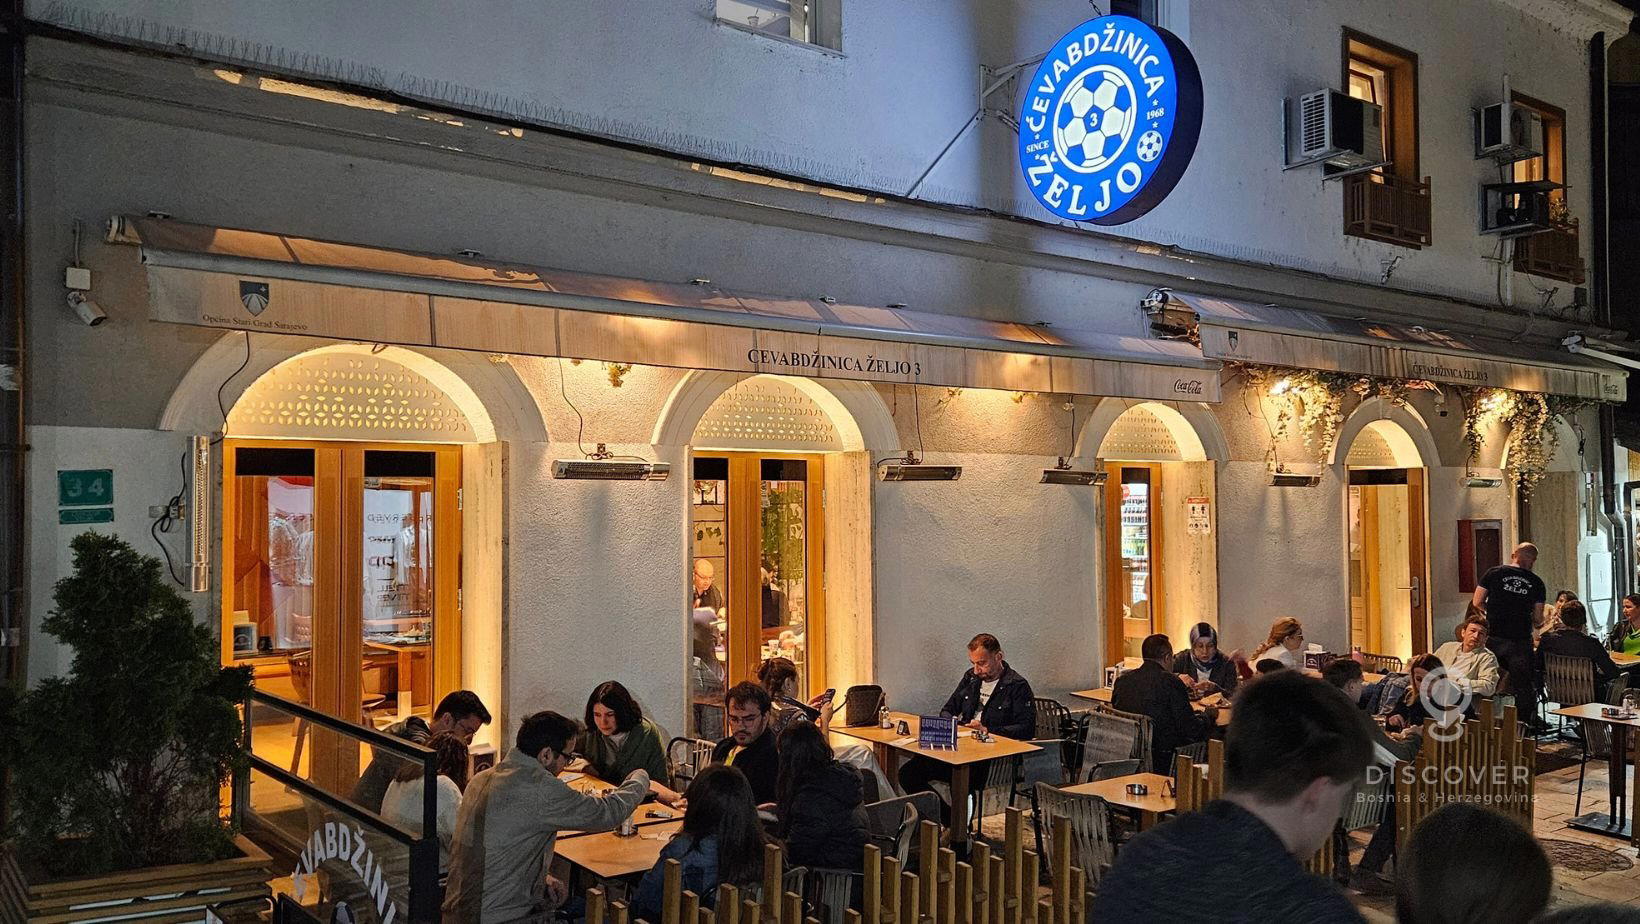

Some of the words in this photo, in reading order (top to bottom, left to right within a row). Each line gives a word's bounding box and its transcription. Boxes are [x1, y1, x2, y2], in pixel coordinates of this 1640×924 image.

[1089, 112, 1098, 127] 3
[1146, 107, 1164, 120] 1968
[1026, 140, 1050, 153] SINCE
[1027, 151, 1142, 215] ŽELJO
[274, 321, 308, 331] Sarajevo
[866, 355, 911, 375] ŽELJO
[914, 362, 922, 376] 3
[67, 477, 104, 498] 34
